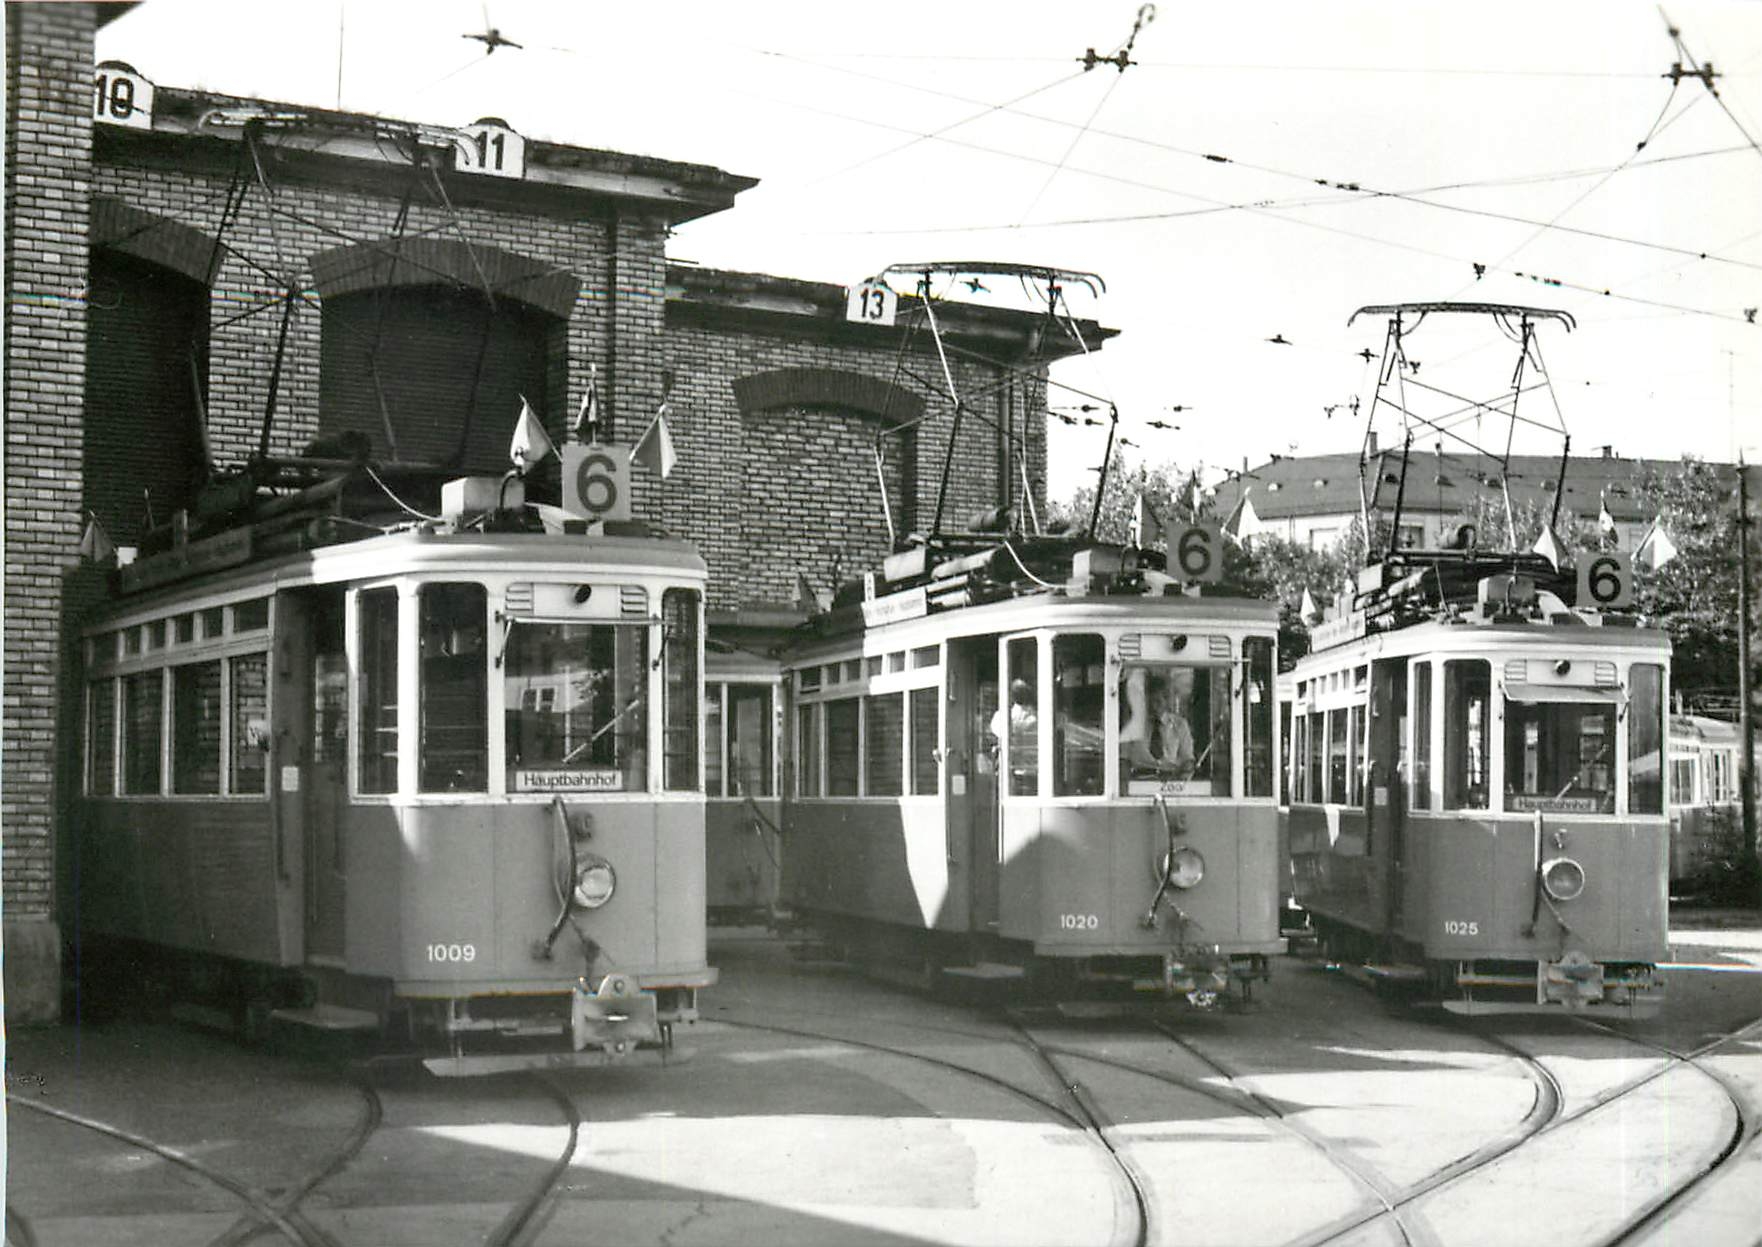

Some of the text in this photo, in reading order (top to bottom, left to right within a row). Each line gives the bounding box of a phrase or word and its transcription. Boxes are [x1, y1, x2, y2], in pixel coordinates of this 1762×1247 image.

[96, 75, 134, 119] 10
[476, 131, 504, 170] 11
[860, 288, 885, 319] 13
[577, 453, 618, 513] 6
[1178, 528, 1211, 576] 6
[1588, 557, 1621, 602] 6
[524, 773, 616, 789] Hauptbahnhof
[1060, 914, 1099, 929] 1020
[1445, 921, 1479, 935] 1025
[427, 944, 476, 962] 1009
